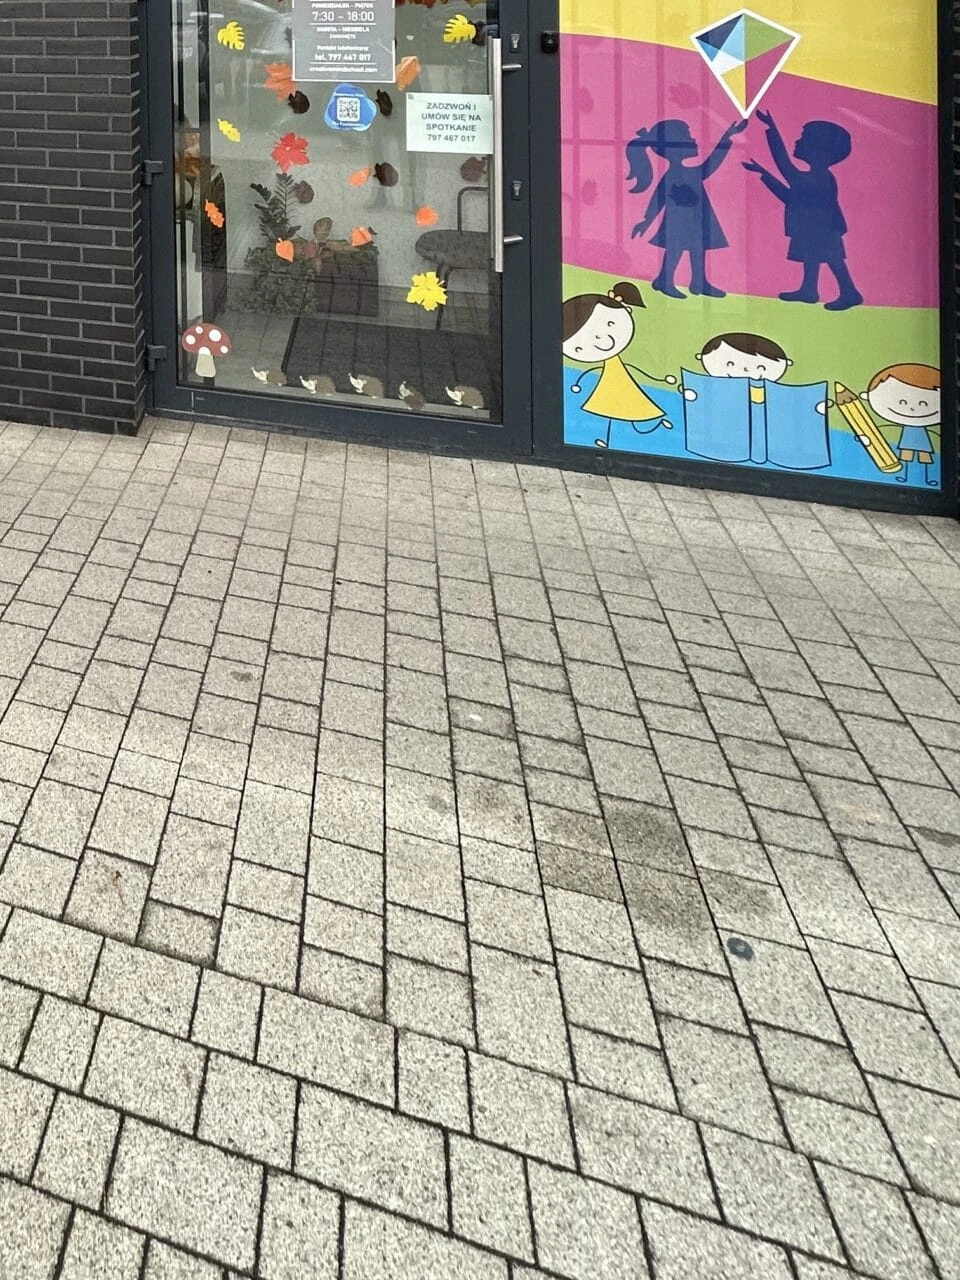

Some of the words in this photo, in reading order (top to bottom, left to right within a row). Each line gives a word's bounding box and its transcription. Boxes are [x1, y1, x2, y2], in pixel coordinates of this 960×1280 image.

[312, 11, 335, 21] 7:30
[347, 11, 375, 21] 18:00
[327, 53, 342, 61] 797
[343, 53, 358, 61] 467
[358, 53, 372, 61] 017
[426, 102, 472, 111] ZADZWOŃ
[421, 112, 450, 121] UMÓW
[452, 114, 467, 122] SIĘ
[426, 123, 478, 132] SPOTKANIE
[427, 133, 442, 141] 797
[443, 134, 459, 142] 467
[460, 134, 476, 142] 017
